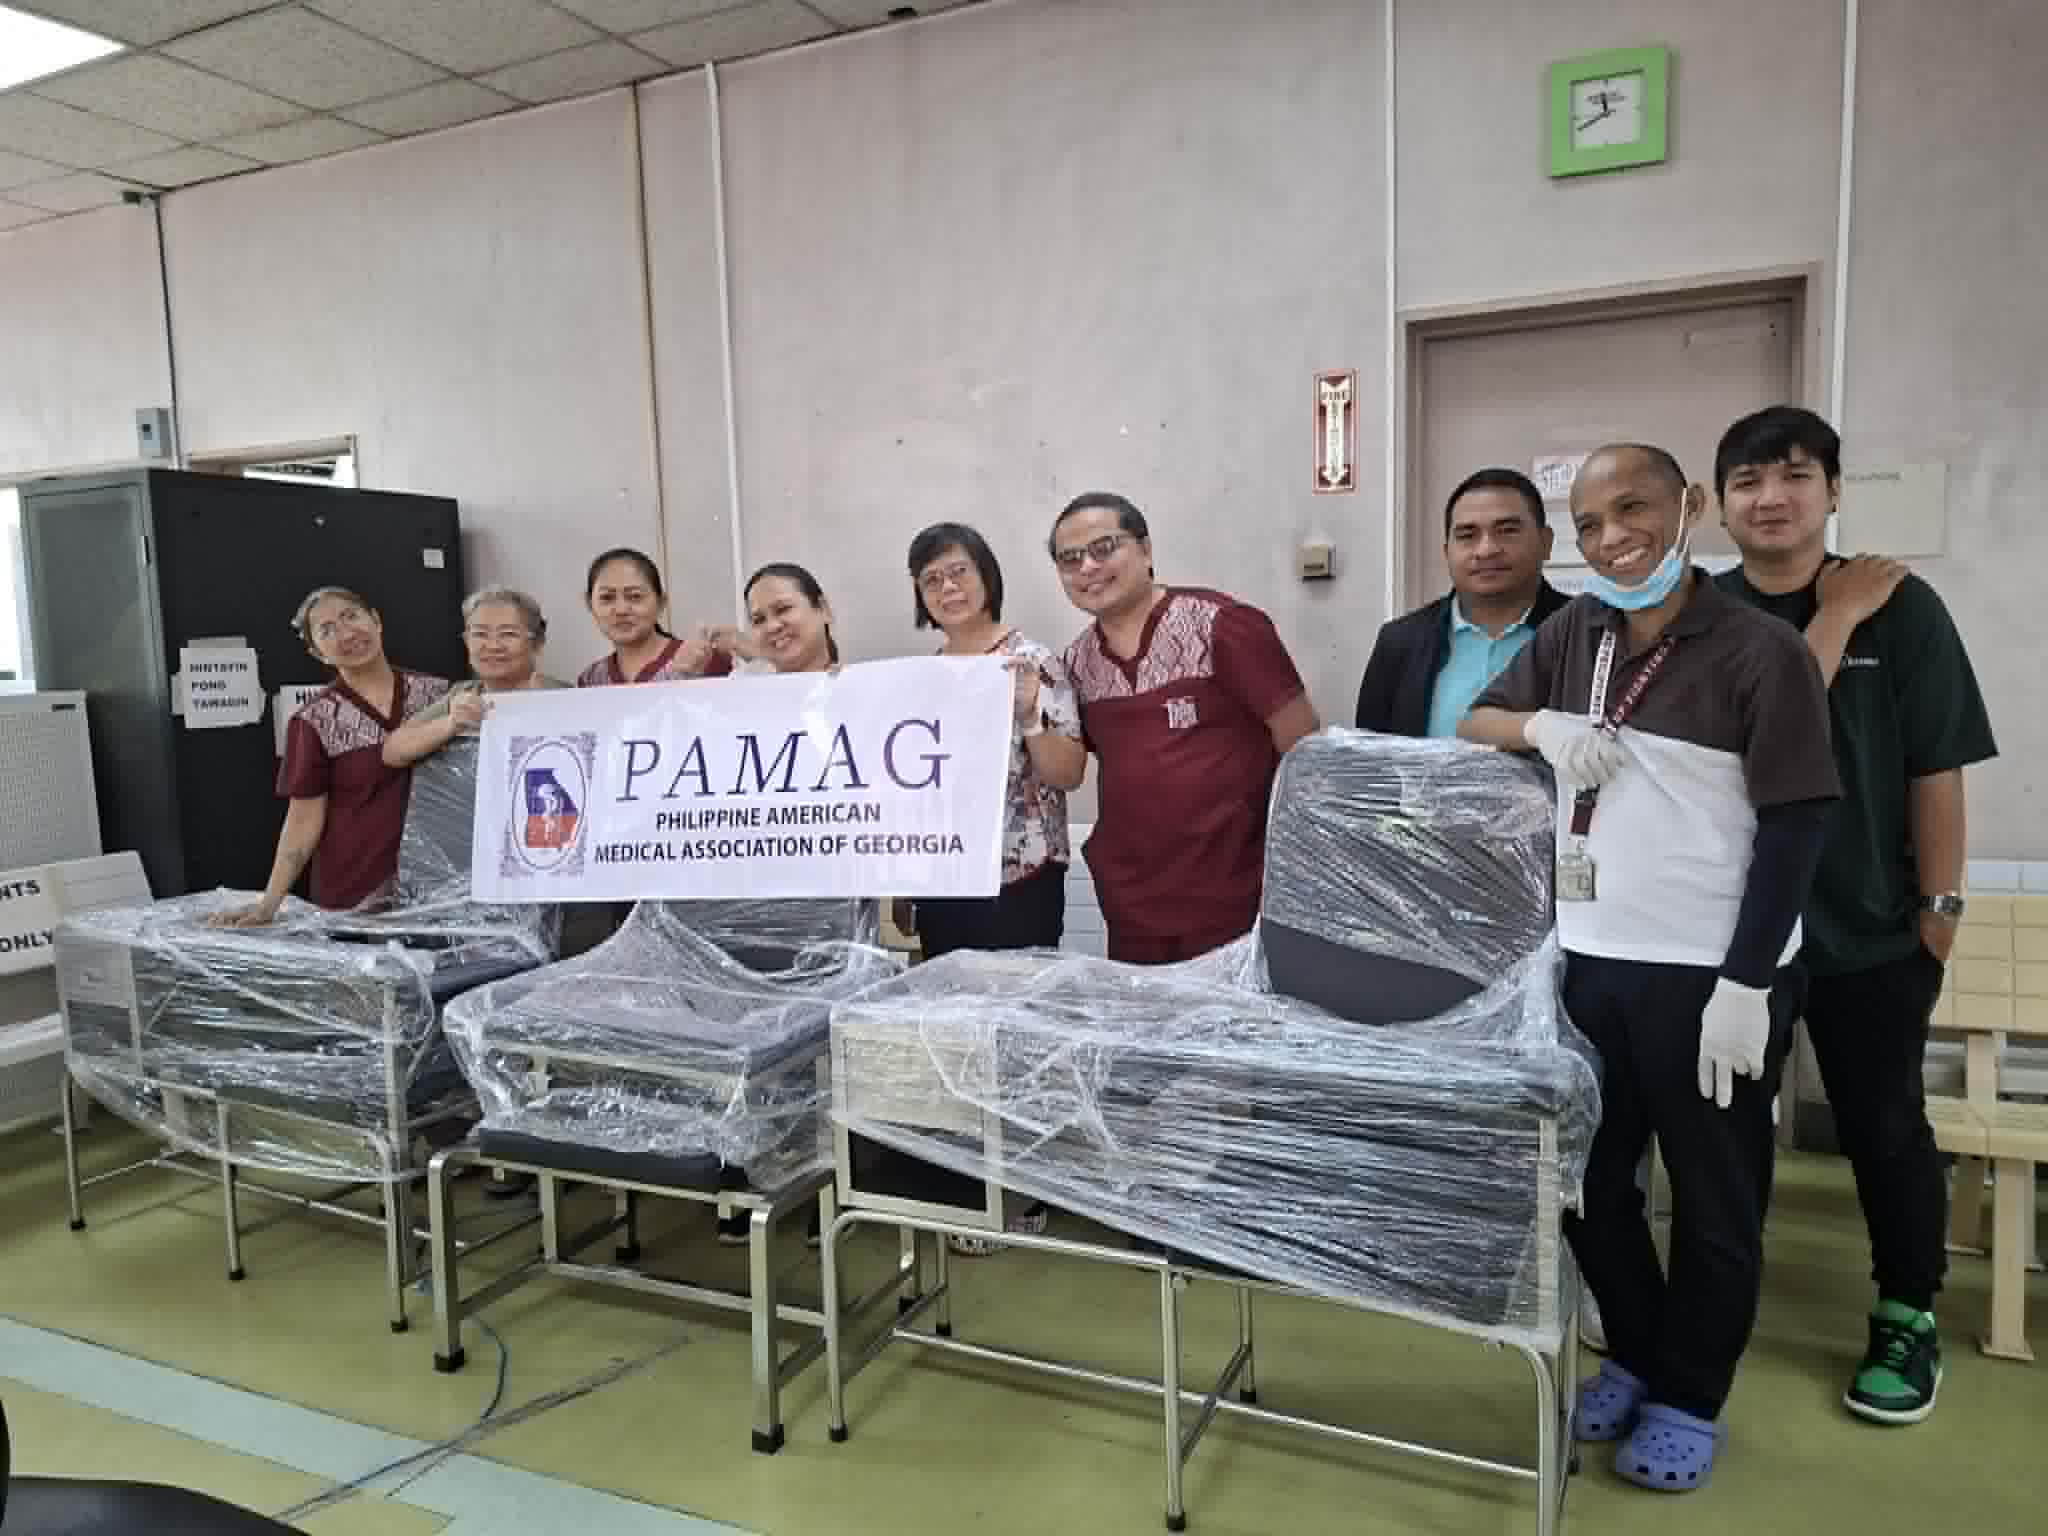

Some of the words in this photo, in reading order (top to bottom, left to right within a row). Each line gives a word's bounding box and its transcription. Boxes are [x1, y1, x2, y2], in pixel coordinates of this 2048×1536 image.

[615, 718, 953, 802] PAMAG
[656, 806, 761, 832] PHILIPPINE
[766, 802, 881, 827] AMERICAN
[594, 840, 677, 864] MEDICAL
[681, 836, 817, 861] ASSOCIATION
[819, 834, 849, 856] OF
[853, 833, 965, 856] GEORGIA
[0, 931, 54, 953] ONLY
